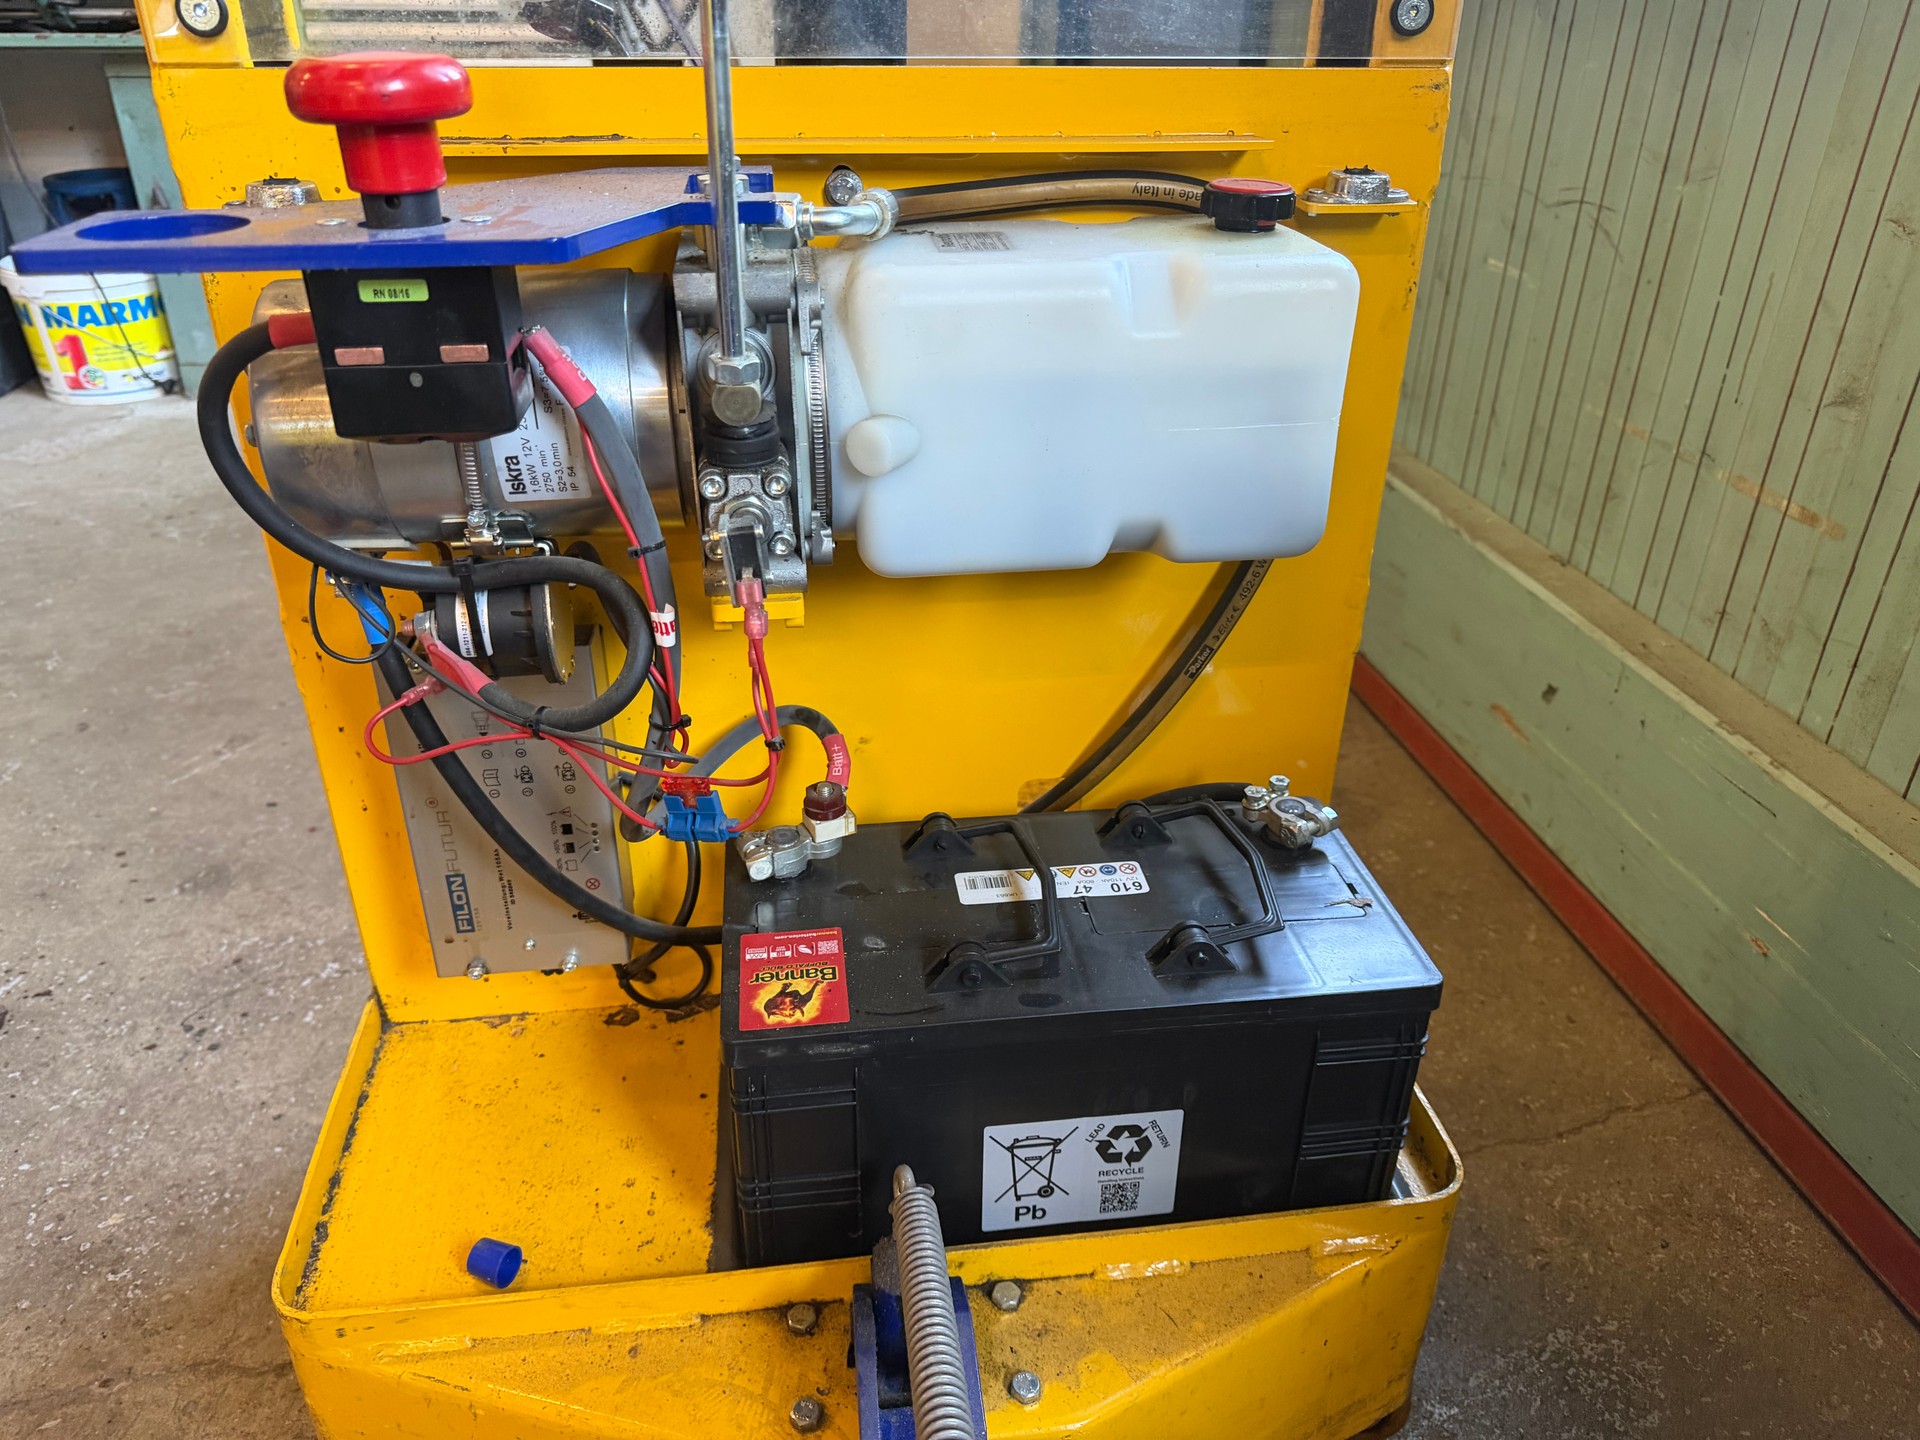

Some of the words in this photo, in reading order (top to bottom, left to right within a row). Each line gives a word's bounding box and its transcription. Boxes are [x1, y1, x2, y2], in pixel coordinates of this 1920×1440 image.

[1131, 181, 1160, 198] Italy
[1163, 187, 1176, 200] in
[1178, 188, 1201, 202] ade
[373, 288, 386, 299] RN
[388, 287, 411, 299] 08/16
[520, 437, 533, 458] 12V
[504, 455, 528, 495] Iskra
[526, 464, 541, 493] 1,6kW
[567, 465, 577, 479] 54
[542, 472, 555, 493] 2750
[570, 482, 580, 492] IP
[1187, 646, 1212, 677] Parker
[1239, 570, 1261, 601] 492-6
[831, 743, 844, 777] Batt+
[436, 810, 461, 875] FUTUR
[1073, 884, 1093, 895] 47
[1111, 881, 1143, 893] 610
[452, 875, 473, 931] FILON
[786, 961, 829, 969] BUFFALO
[749, 966, 838, 984] Banner
[1085, 1122, 1106, 1143] LEAD
[1148, 1119, 1171, 1149] RETURN
[1098, 1166, 1145, 1177] RECYCLE
[1014, 1204, 1047, 1222] Pb
